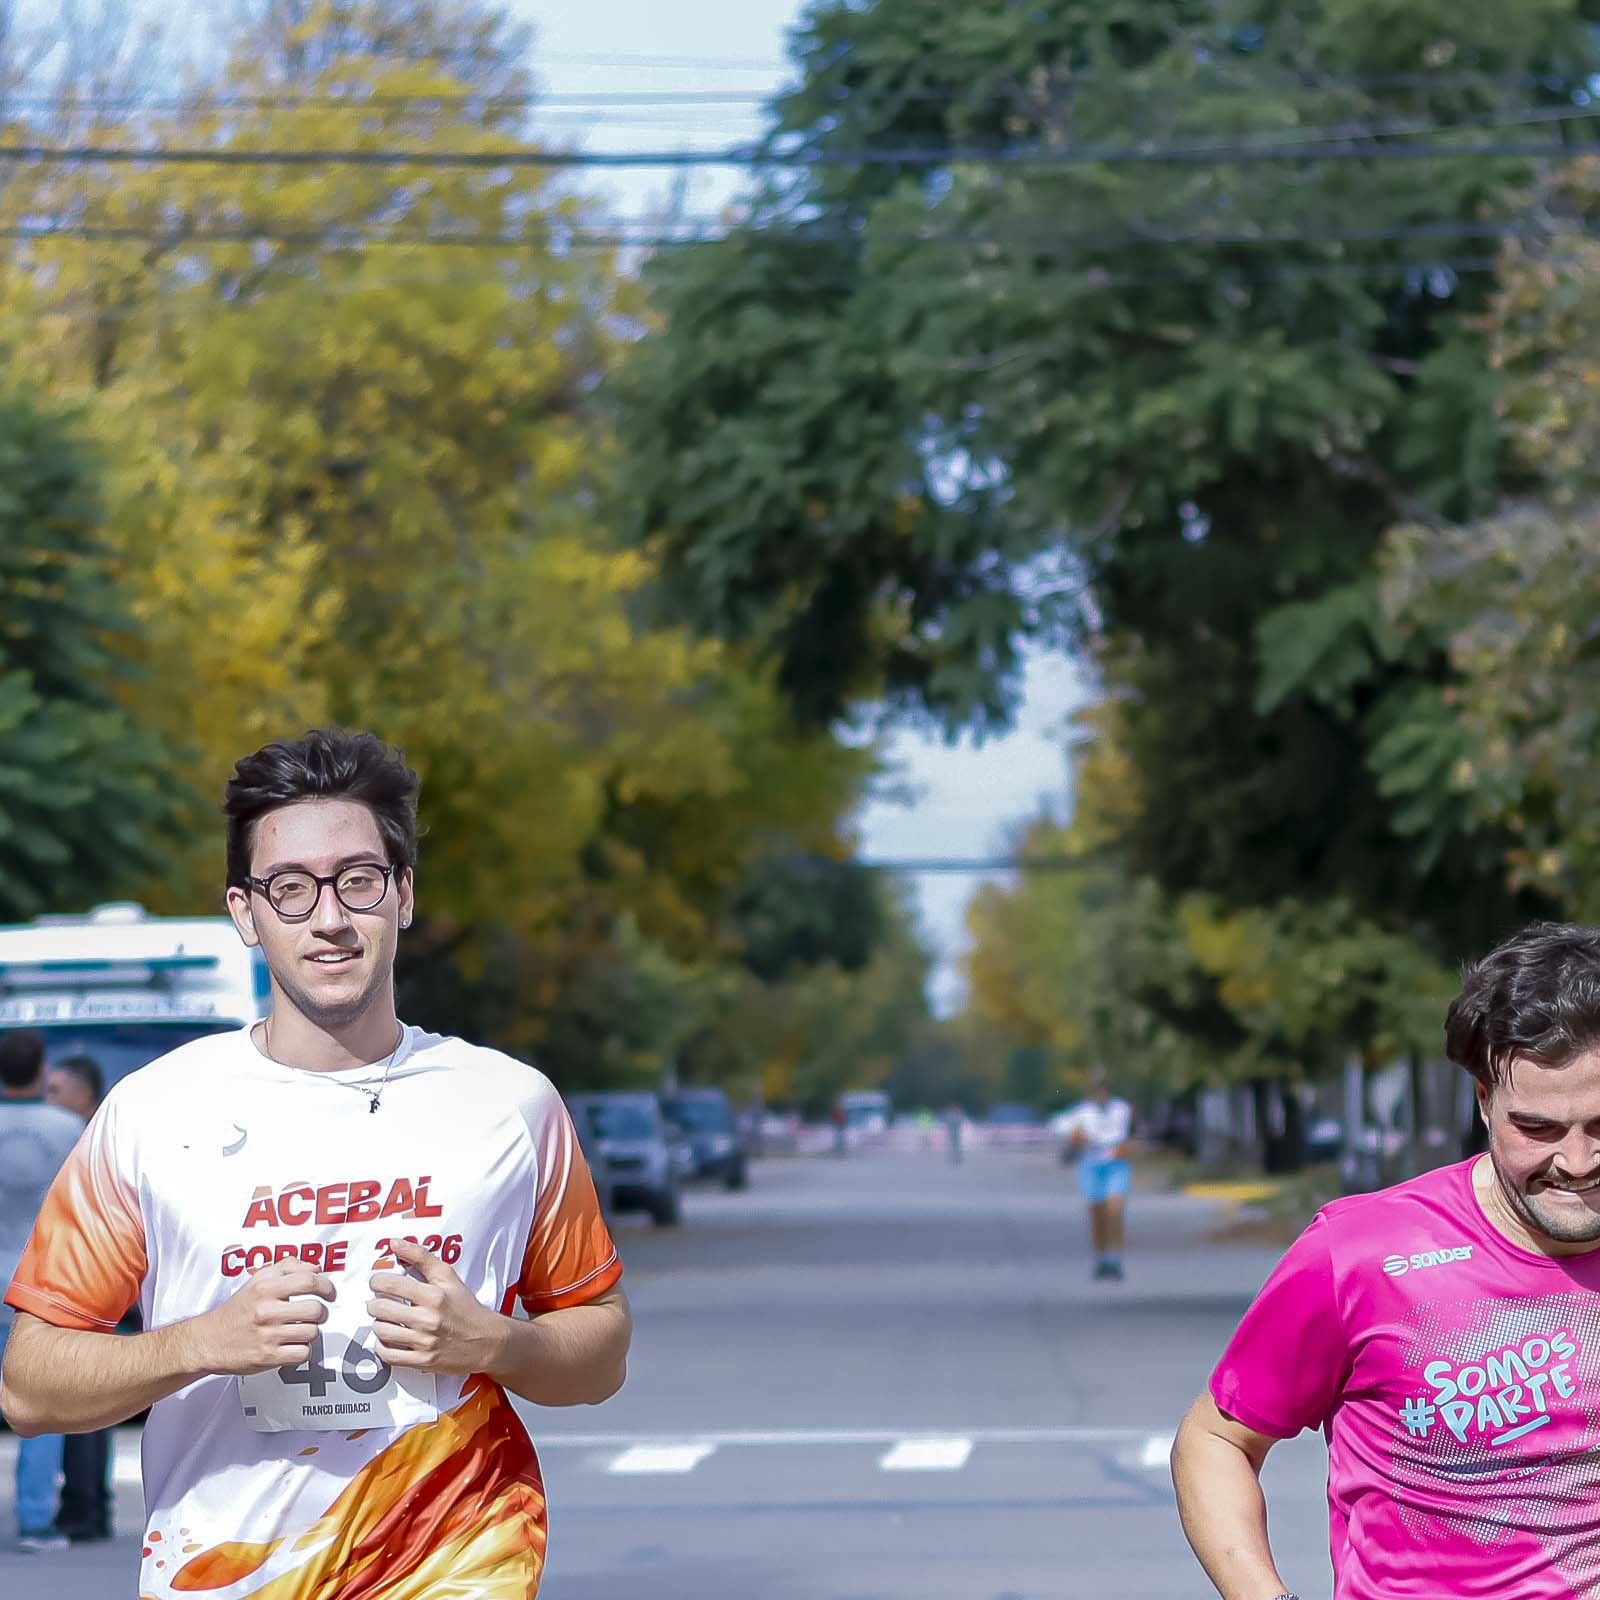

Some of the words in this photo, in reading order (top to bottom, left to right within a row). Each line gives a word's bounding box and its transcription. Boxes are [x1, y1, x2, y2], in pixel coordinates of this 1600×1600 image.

[241, 1175, 443, 1229] ACEBAL
[277, 1325, 392, 1398] 46
[1423, 1331, 1576, 1405] SOMOS
[302, 1404, 333, 1416] FRANCO
[335, 1402, 371, 1415] GUIDACCI
[1399, 1363, 1576, 1443] #PARTE
